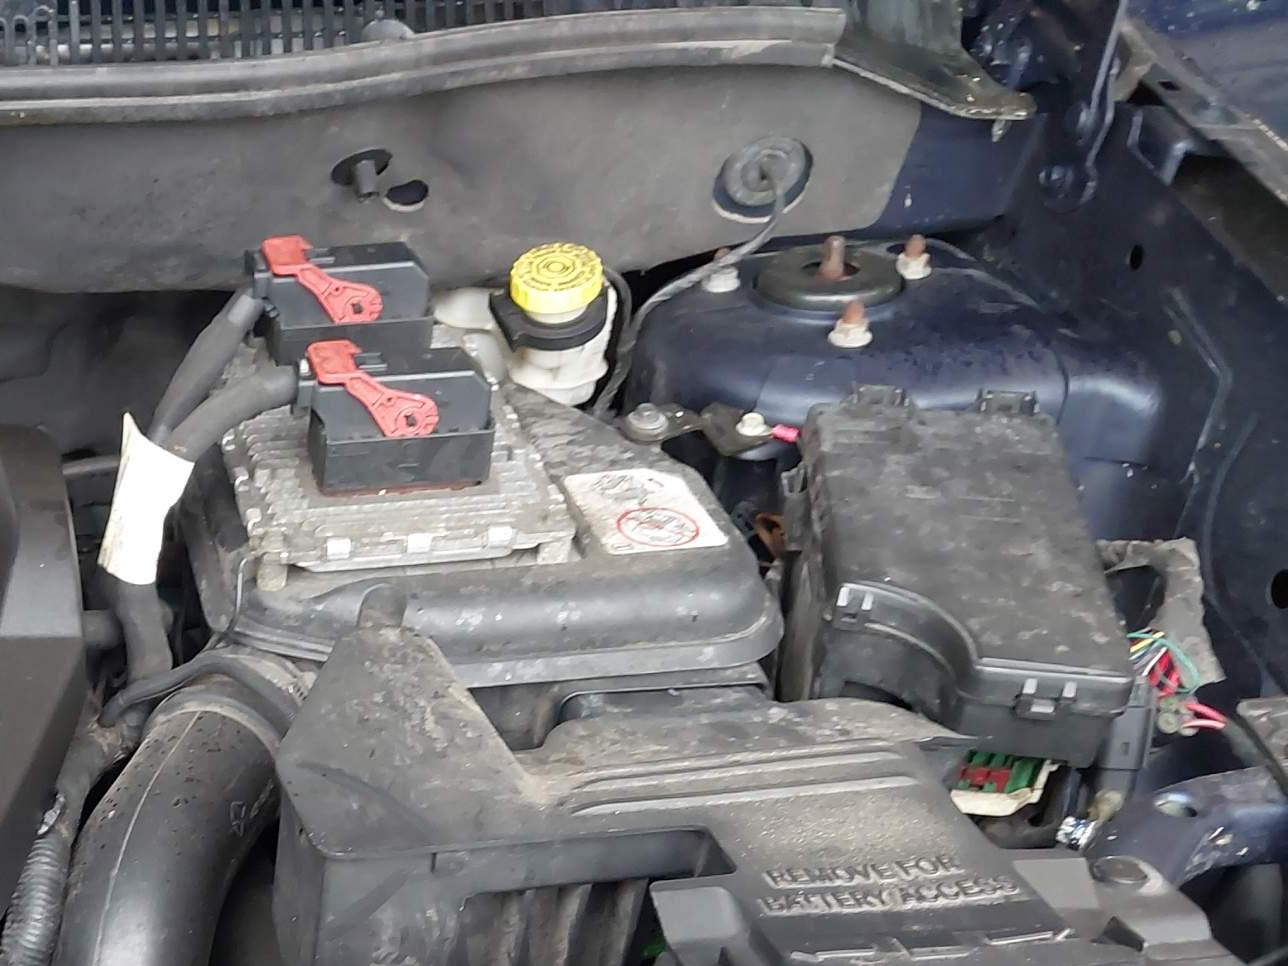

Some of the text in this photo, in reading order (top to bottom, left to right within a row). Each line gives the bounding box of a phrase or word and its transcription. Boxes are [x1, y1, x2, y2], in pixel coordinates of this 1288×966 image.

[764, 853, 965, 888] REMOVE FOR
[760, 873, 1021, 916] BATTERY ACCESS
